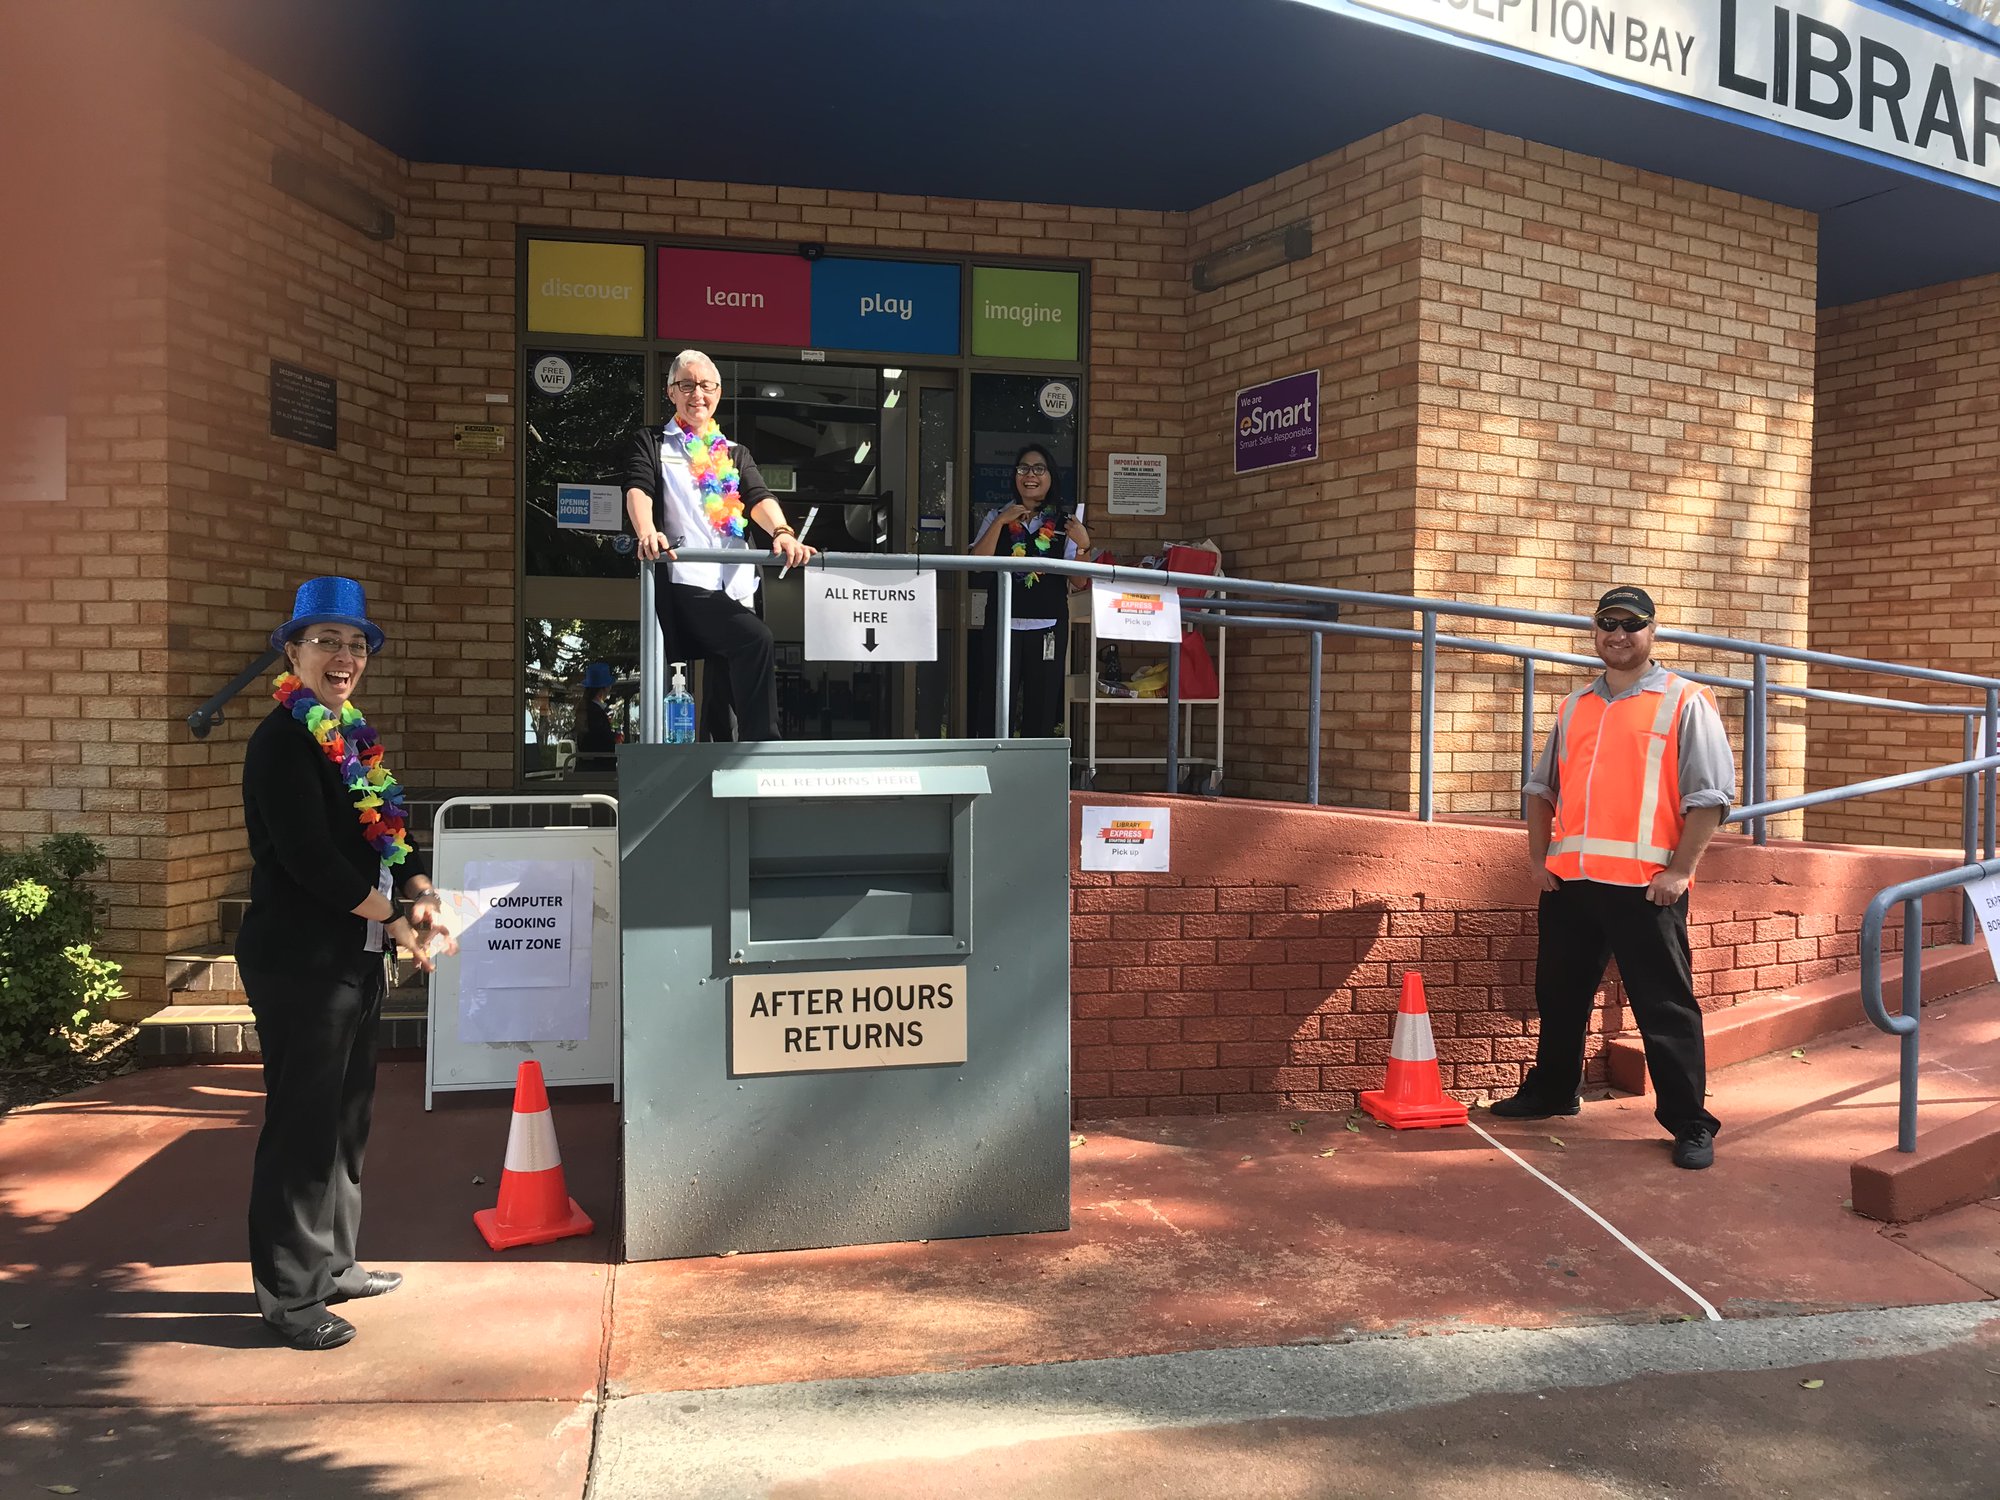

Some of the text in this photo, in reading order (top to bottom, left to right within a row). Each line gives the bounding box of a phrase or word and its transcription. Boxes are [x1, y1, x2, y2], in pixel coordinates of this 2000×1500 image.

[1625, 16, 1695, 76] BAY
[541, 278, 632, 300] discover
[705, 286, 764, 309] learn
[860, 294, 913, 320] play
[984, 300, 1062, 328] imagine
[542, 366, 564, 375] FREE
[540, 374, 565, 384] WiFi
[1046, 392, 1067, 400] FREE
[1240, 396, 1262, 407] We are
[1045, 399, 1067, 409] WiFi
[1240, 397, 1312, 437] eSmart
[560, 506, 588, 515] HOURS
[825, 588, 916, 601] ALL RETURNS
[1121, 600, 1153, 609] EXPRESS
[853, 611, 888, 624] HERE
[1142, 619, 1152, 627] up
[760, 774, 918, 788] ALL RETURNS HERE
[1109, 829, 1142, 837] EXPRESS
[490, 896, 563, 907] COMPUTER
[495, 917, 556, 929] BOOKING
[488, 938, 562, 950] WAIT ZONE
[750, 983, 954, 1018] AFTER HOURS
[784, 1020, 924, 1053] RETURNS
